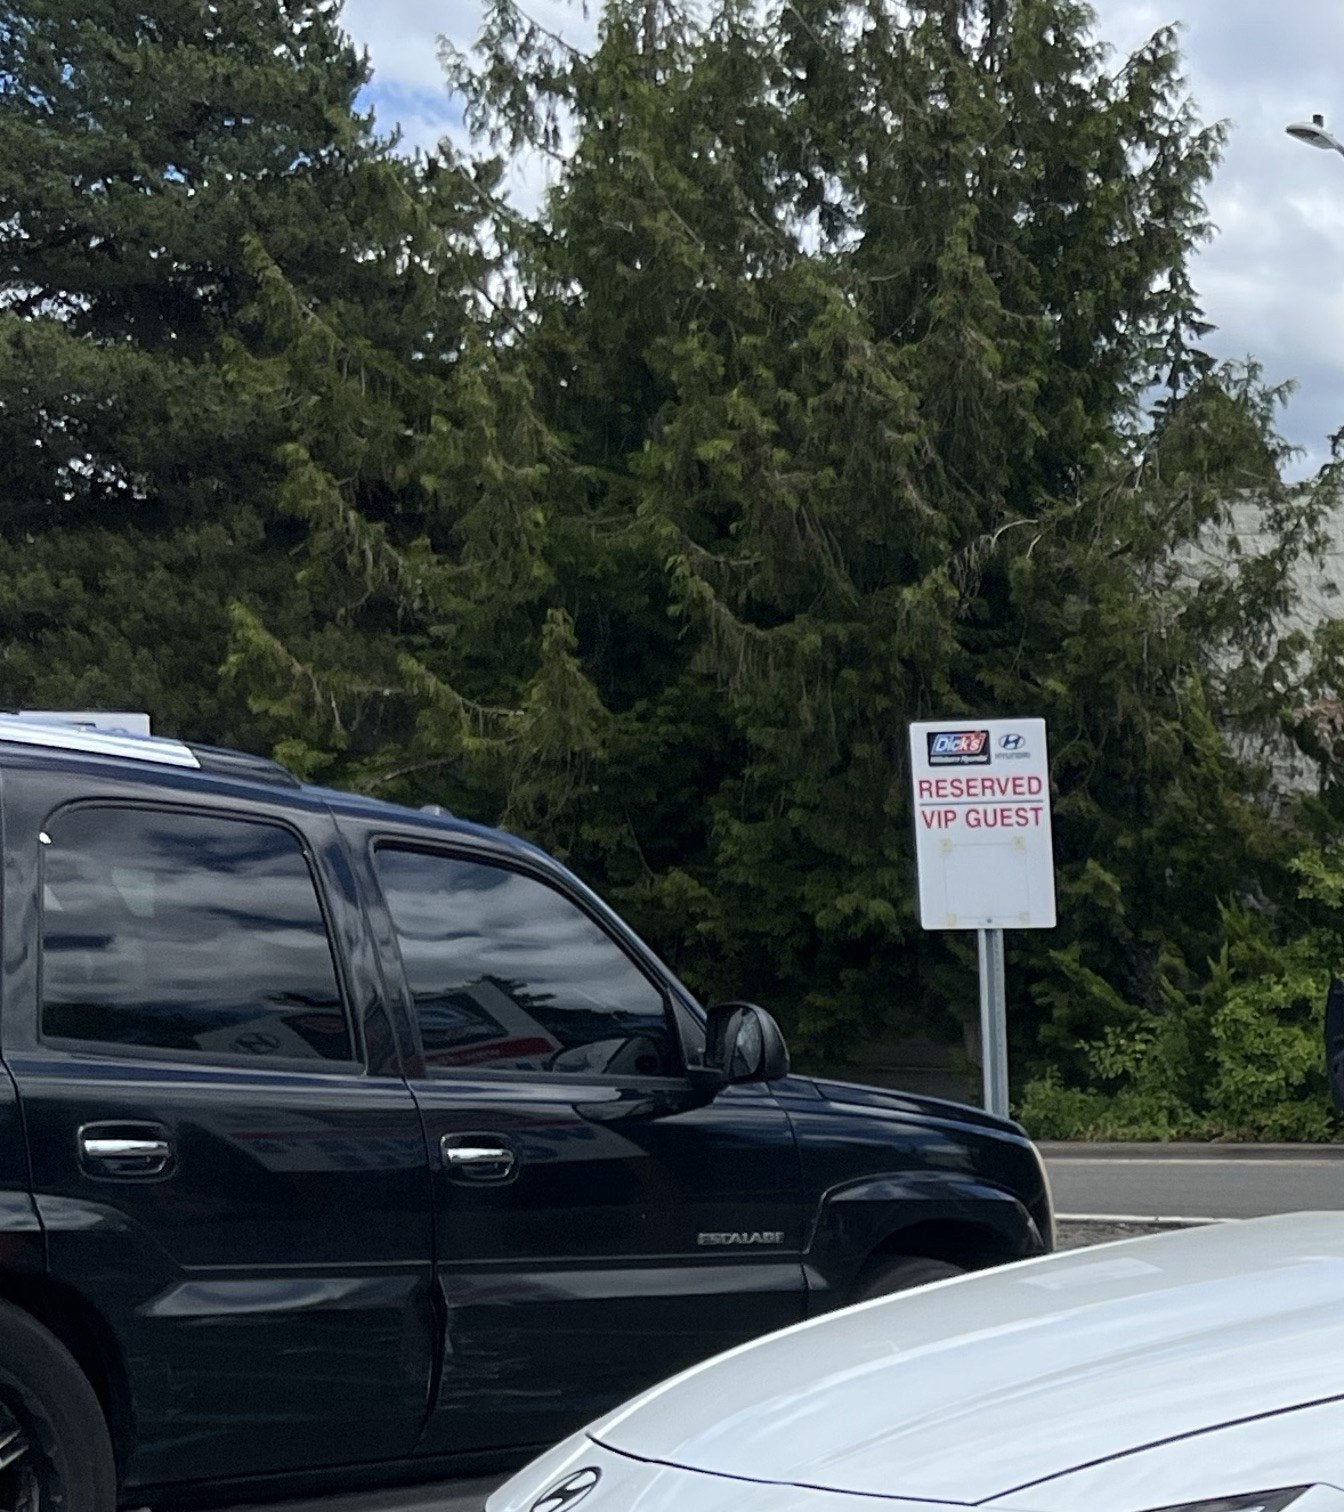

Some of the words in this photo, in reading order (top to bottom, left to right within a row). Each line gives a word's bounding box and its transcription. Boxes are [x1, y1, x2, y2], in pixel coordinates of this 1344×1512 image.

[918, 776, 1042, 798] RESERVED
[921, 809, 957, 829] VIP
[965, 807, 1044, 828] GUEST
